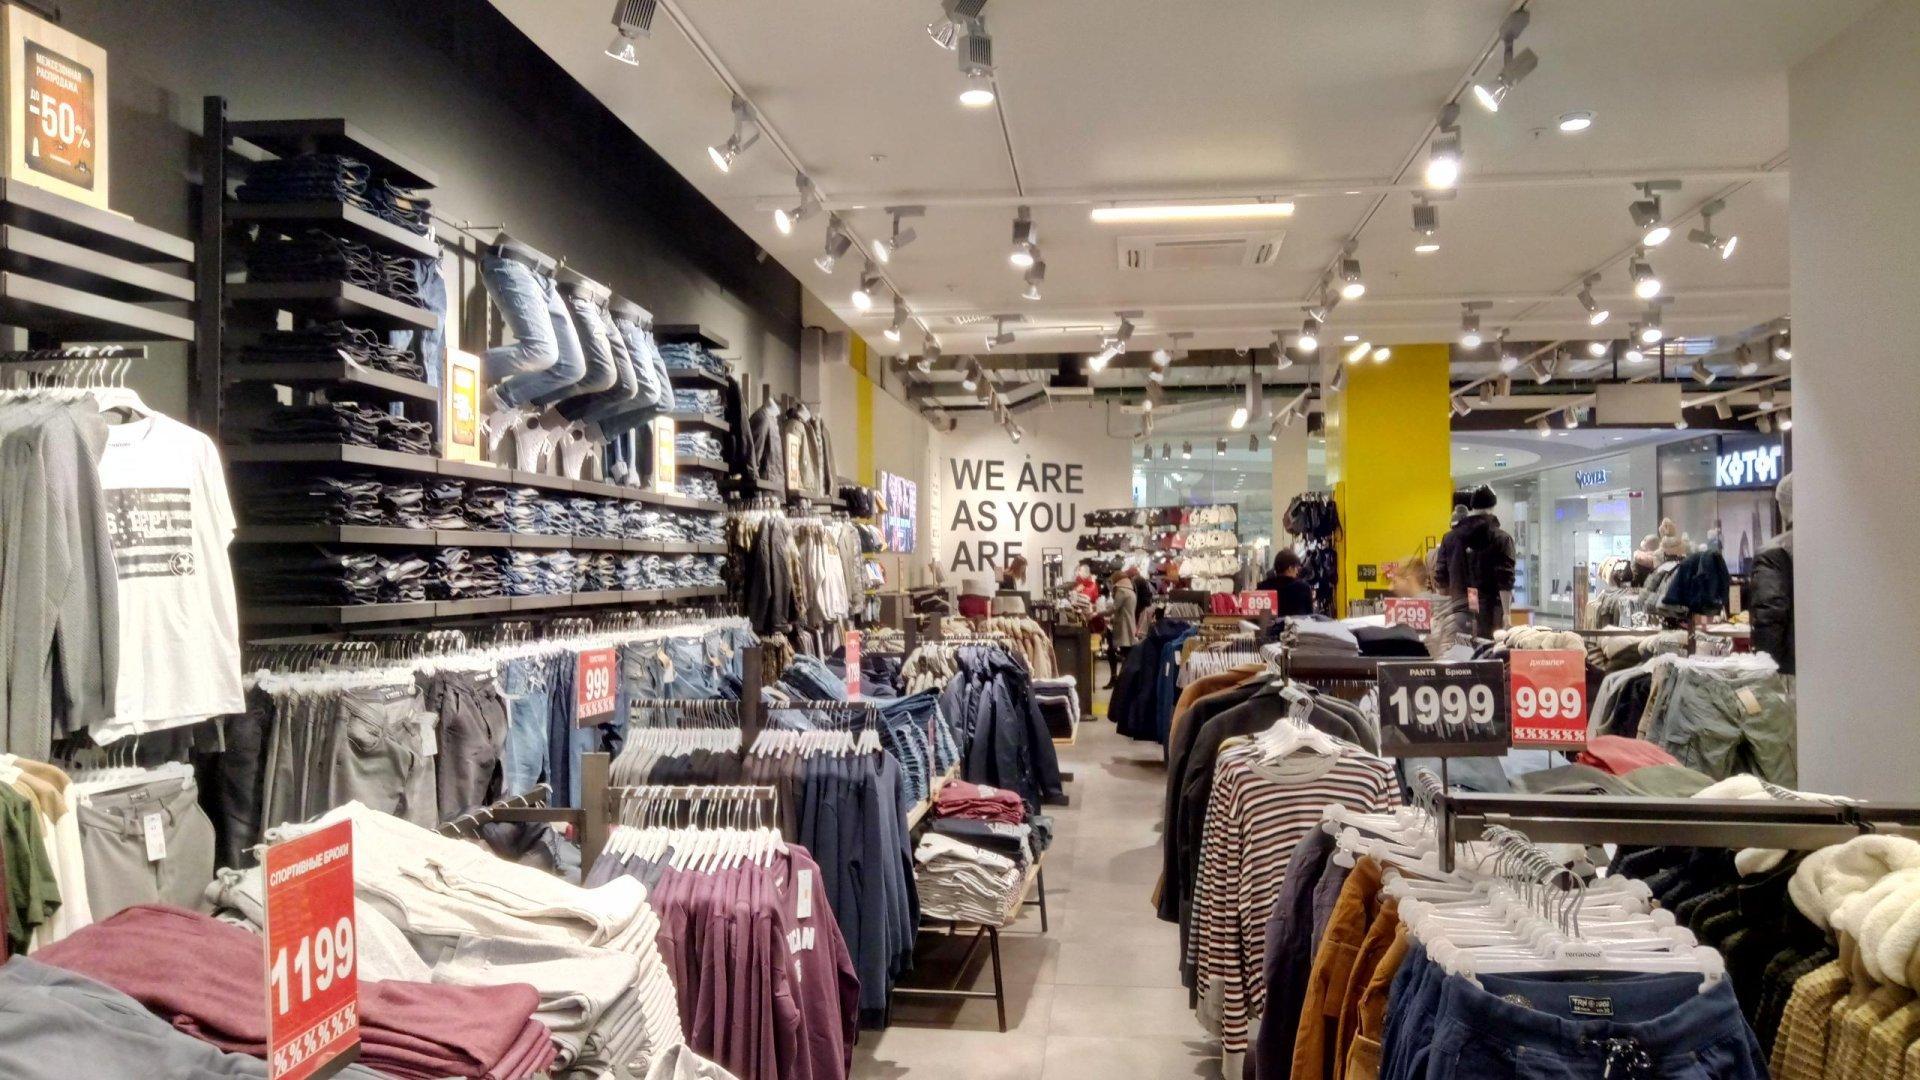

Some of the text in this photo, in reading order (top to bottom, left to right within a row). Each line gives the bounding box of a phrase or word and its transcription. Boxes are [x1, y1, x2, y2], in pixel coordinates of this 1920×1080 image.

[36, 65, 79, 94] РАСПРОДАЖА
[950, 457, 1084, 494] WE ARE
[950, 500, 998, 532] AS
[1007, 501, 1076, 533] YOU
[1248, 596, 1272, 610] 899
[1387, 606, 1427, 623] 1299
[585, 666, 610, 701] 999
[1409, 667, 1472, 677] PANTS Брюки
[1389, 684, 1495, 725] 1999
[1515, 686, 1582, 719] 999
[269, 842, 349, 887] СПОРТИВНЫЕ БРЮКИ
[271, 916, 354, 1016] 1199
